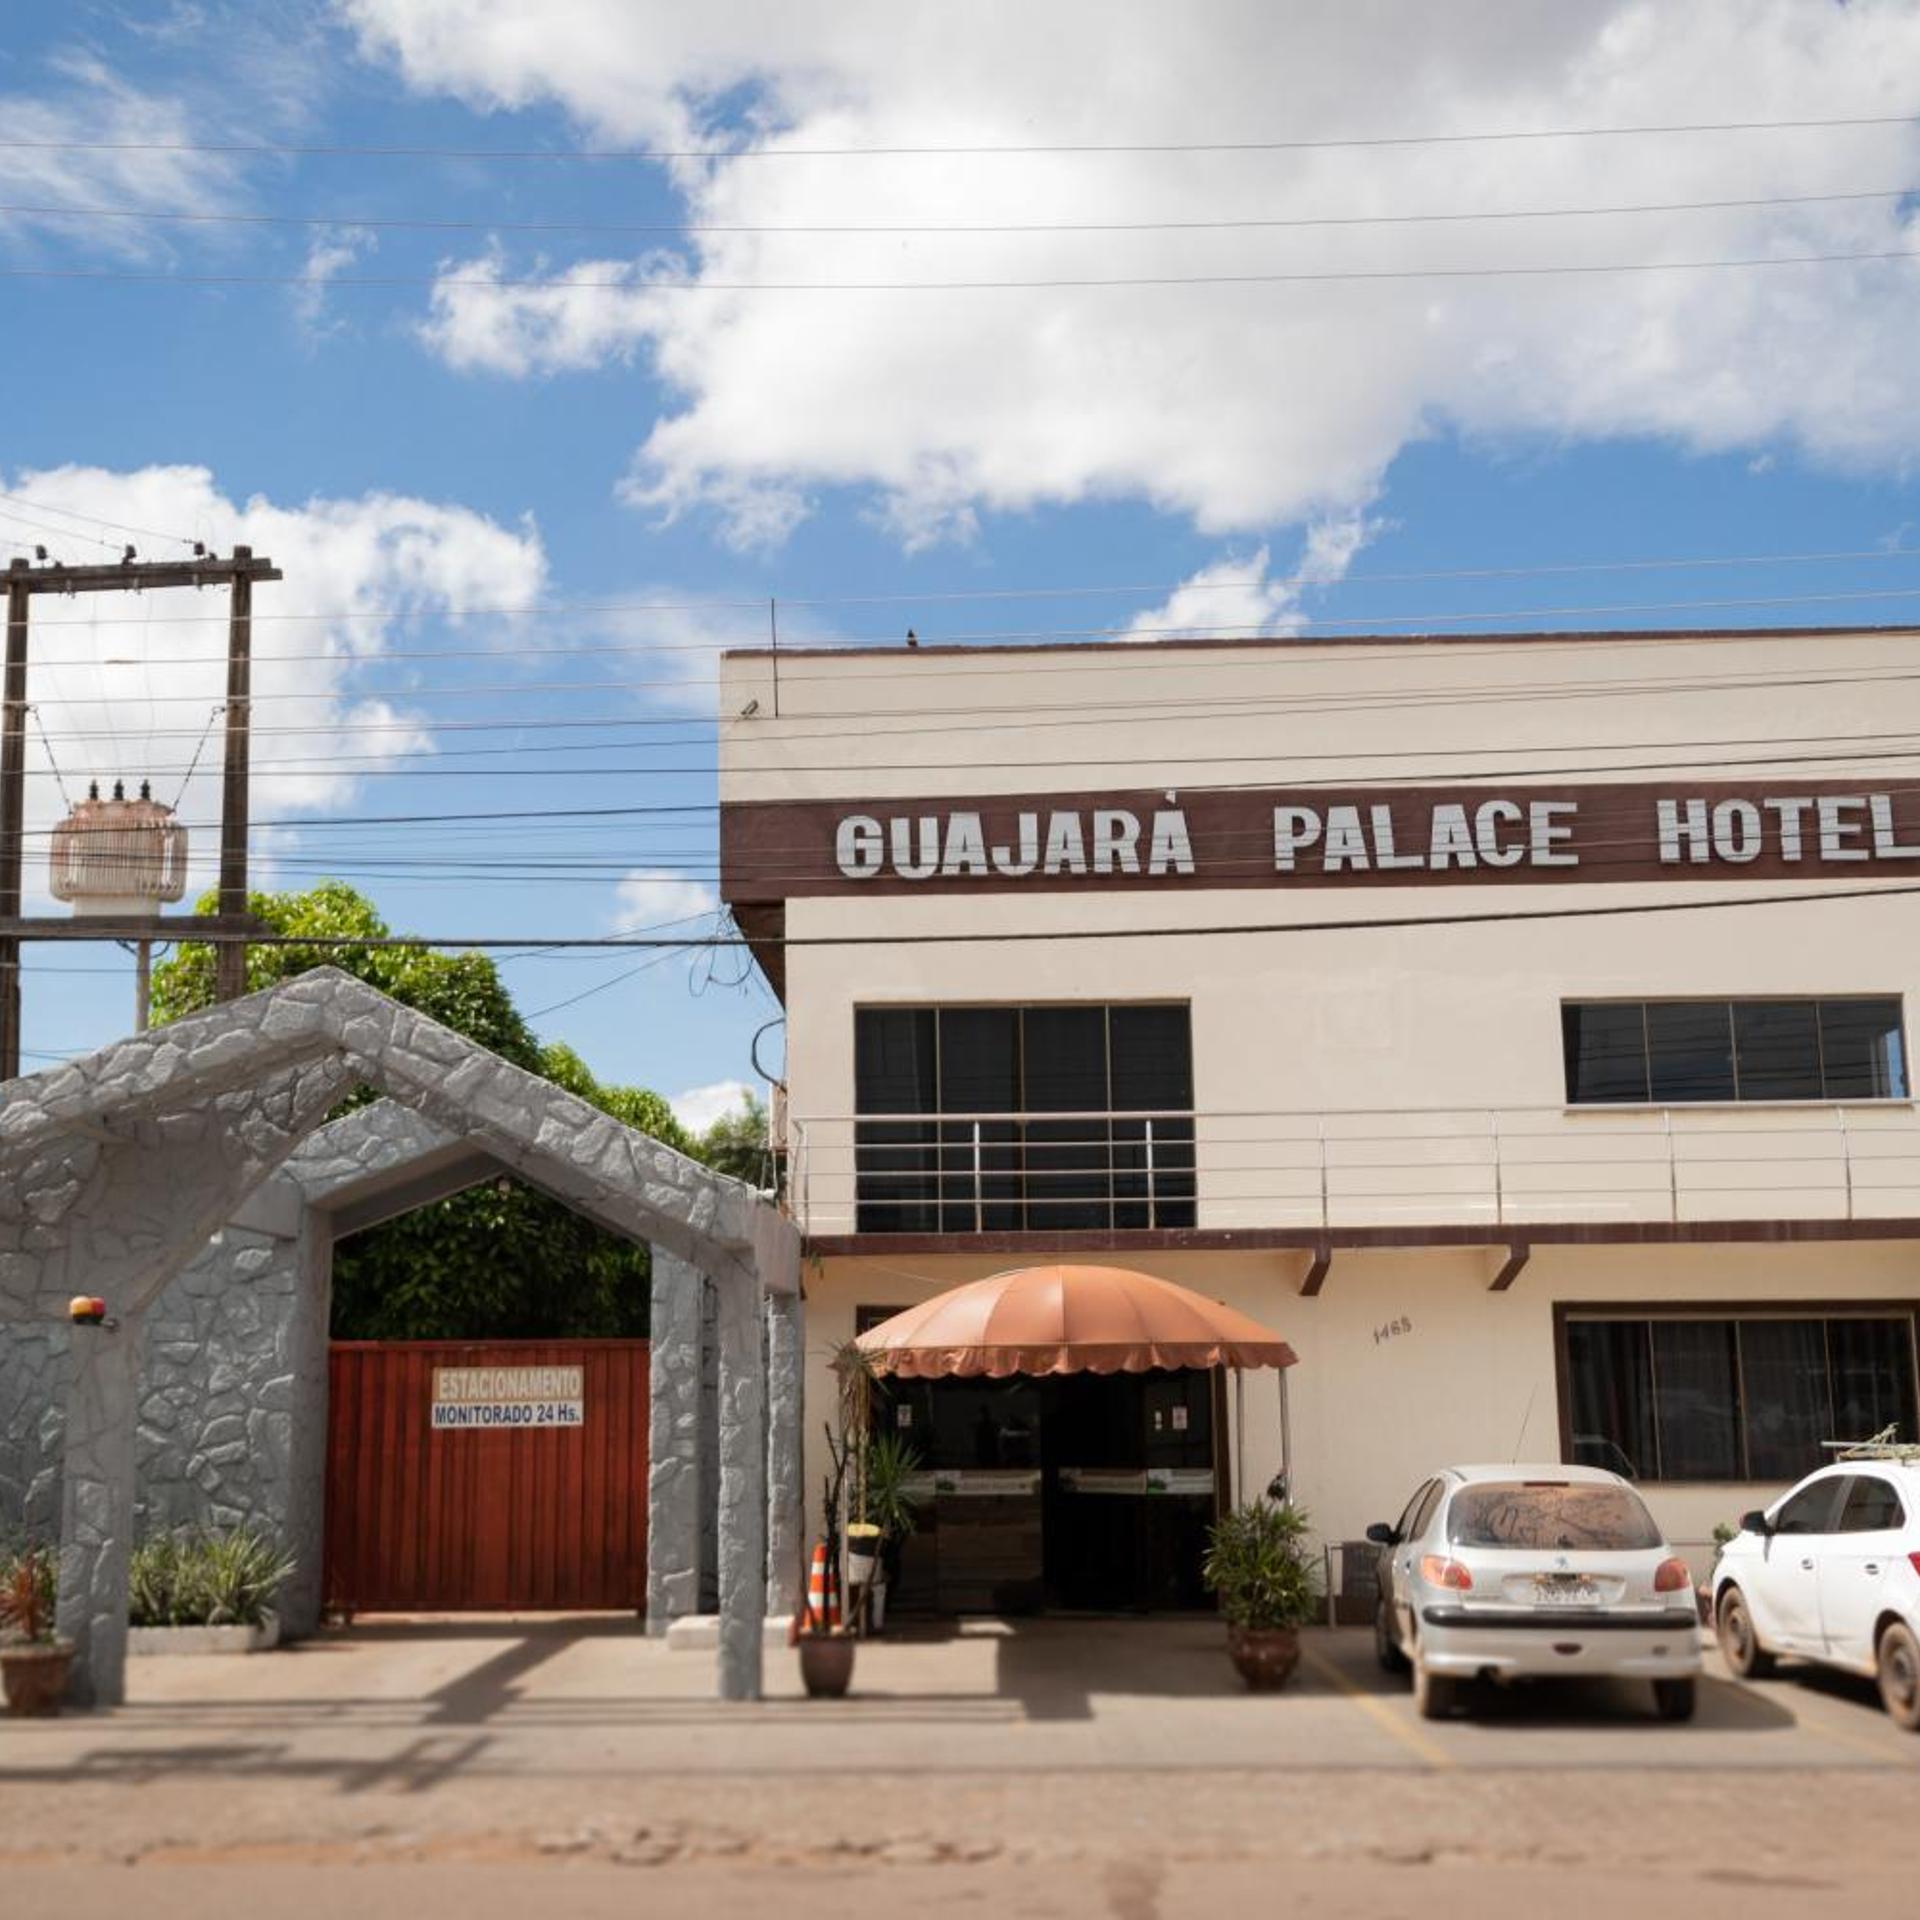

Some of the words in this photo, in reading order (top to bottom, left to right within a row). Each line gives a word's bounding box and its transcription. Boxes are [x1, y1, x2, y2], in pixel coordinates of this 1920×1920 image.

[836, 788, 1195, 880] GUAJARÁ
[1274, 799, 1579, 872] PALACE
[1656, 793, 1920, 863] HOTEL
[439, 1369, 581, 1400] ESTACIONAMENTO
[435, 1405, 532, 1424] MONITORADO
[537, 1404, 553, 1423] 24
[558, 1403, 580, 1422] Hs.
